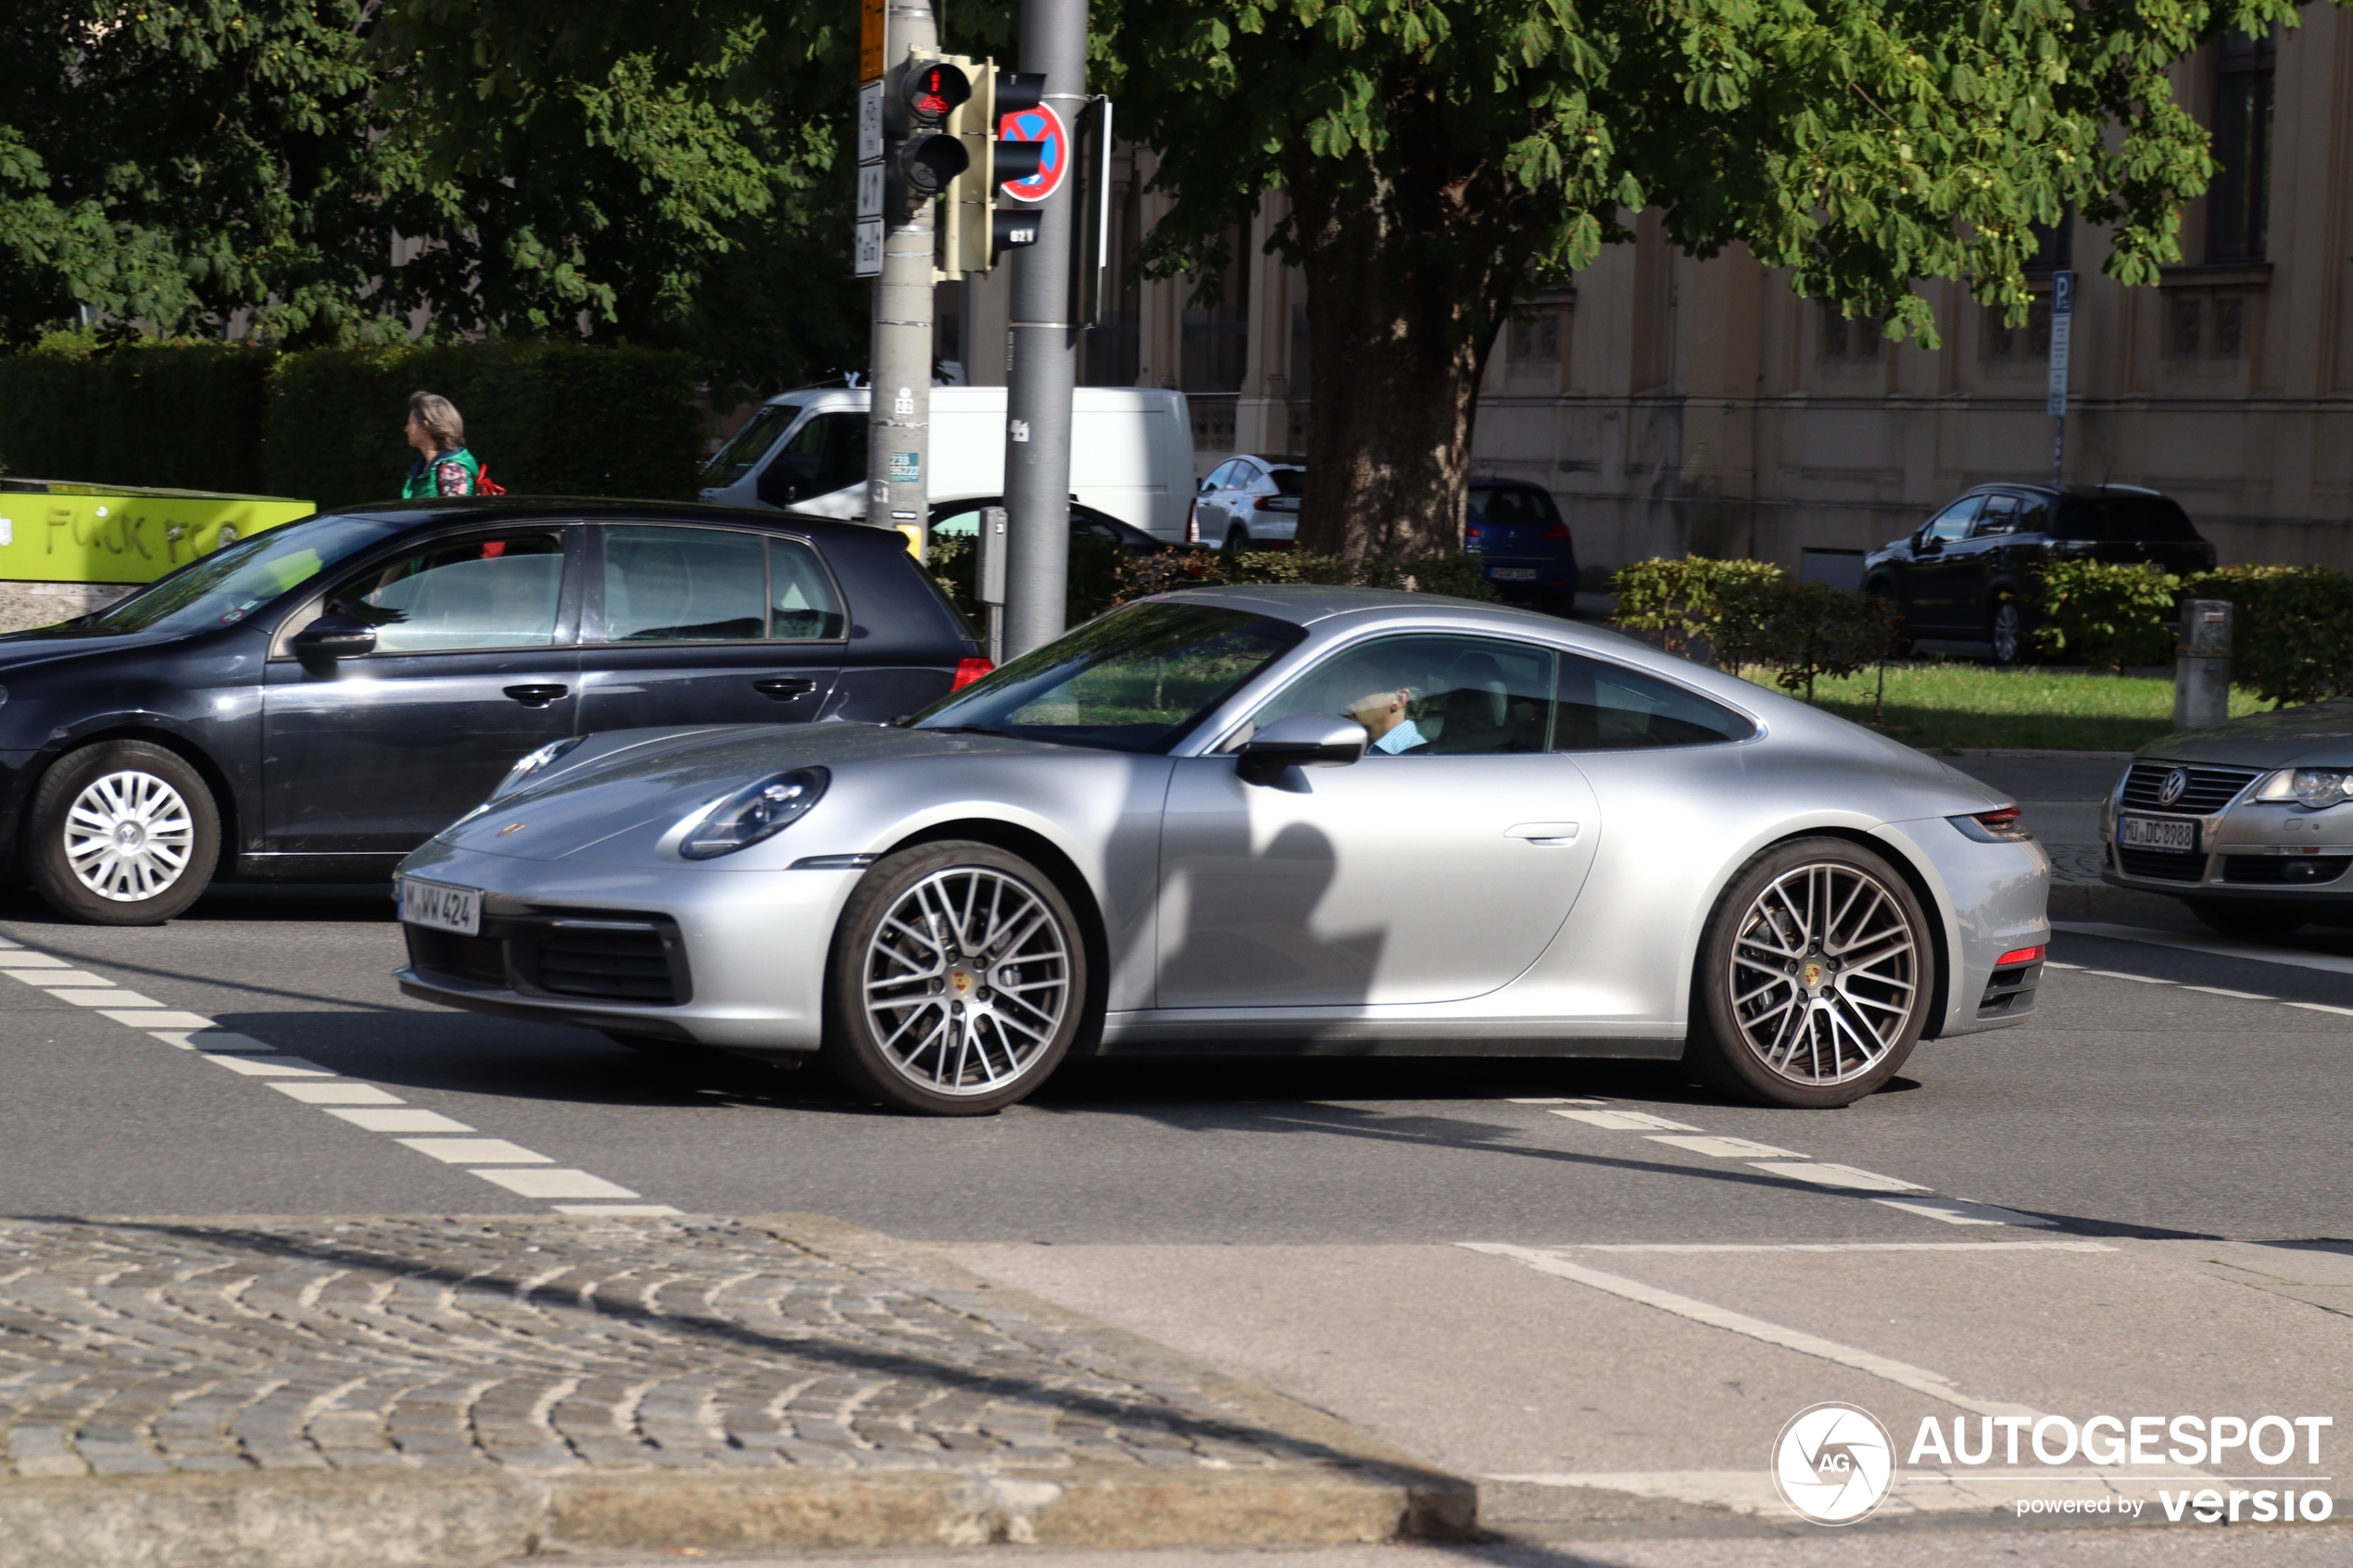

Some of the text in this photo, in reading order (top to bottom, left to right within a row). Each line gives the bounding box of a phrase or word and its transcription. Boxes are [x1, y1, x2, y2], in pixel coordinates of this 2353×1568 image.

[2057, 277, 2069, 309] P
[47, 508, 153, 561] FUCK
[2163, 824, 2191, 847] 8988
[442, 892, 470, 927] 424
